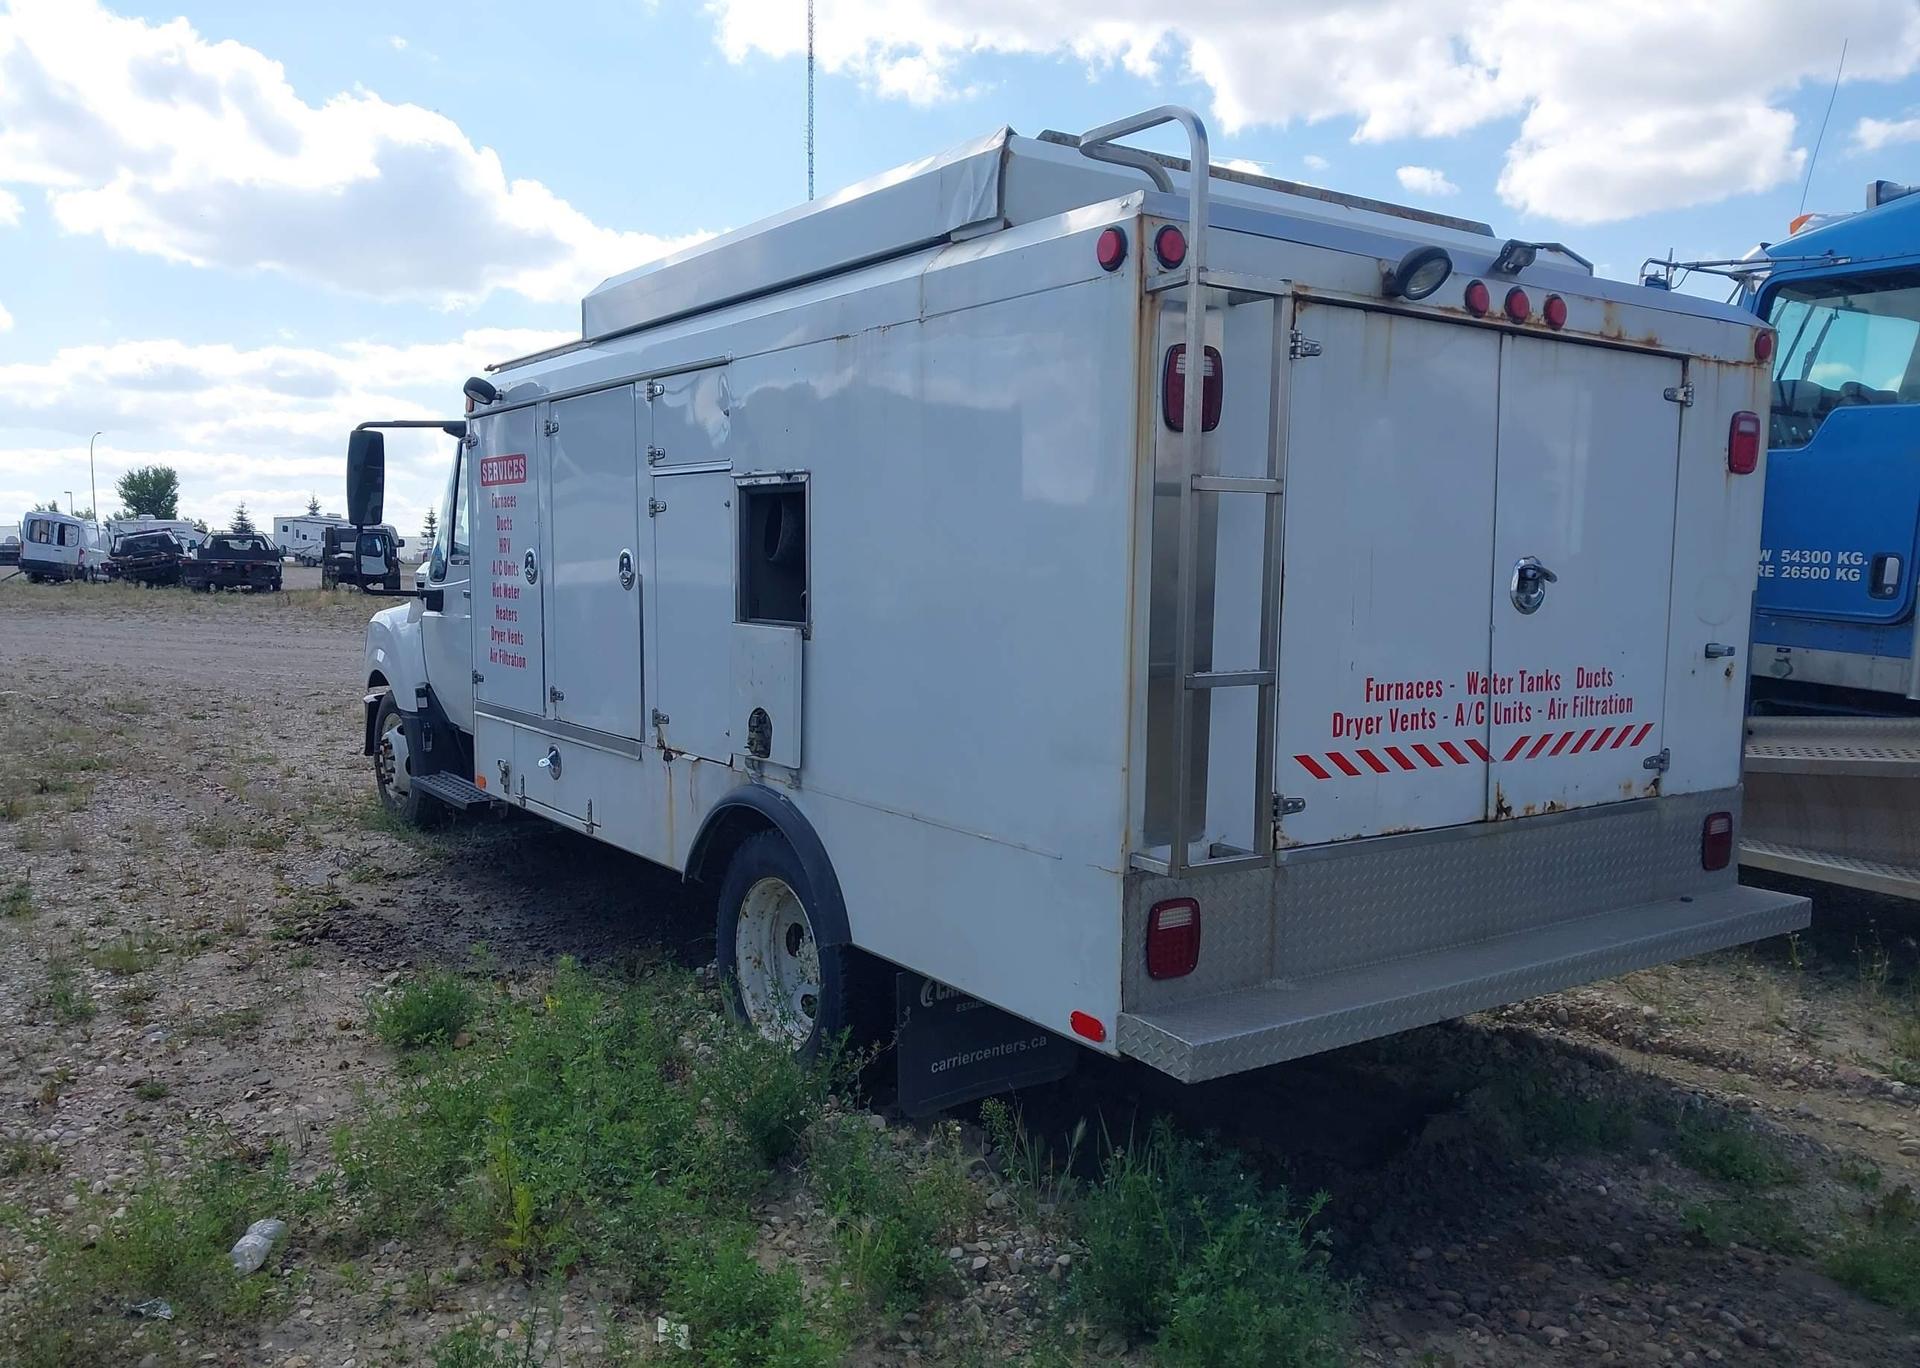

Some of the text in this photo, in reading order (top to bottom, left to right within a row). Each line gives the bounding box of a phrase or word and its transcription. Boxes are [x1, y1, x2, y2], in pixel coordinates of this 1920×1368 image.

[482, 459, 525, 482] SERVICES
[491, 493, 517, 508] Furnaces
[496, 515, 513, 531] Ducts
[498, 537, 511, 554] HRV
[1781, 550, 1832, 564] 54300
[1837, 552, 1869, 565] KG.
[503, 562, 519, 577] Units
[1780, 566, 1831, 580] 26500
[1836, 568, 1861, 581] KG
[492, 582, 521, 600] Hot Water
[495, 604, 518, 622] Heaters
[490, 626, 524, 646] Dryer Vents
[489, 648, 527, 669] Air Filtration
[1365, 677, 1444, 703] Furnaces
[1467, 670, 1514, 696] Water
[1518, 669, 1562, 693] Tanks
[1576, 667, 1614, 690] Ducts
[1332, 712, 1383, 741] Dryer
[1389, 706, 1437, 733] Vents
[1455, 701, 1486, 728] A/C
[1494, 702, 1532, 726] Units
[1548, 697, 1568, 721] Air
[1573, 694, 1634, 717] Filtration
[931, 1035, 1047, 1073] carriercenters.ca
